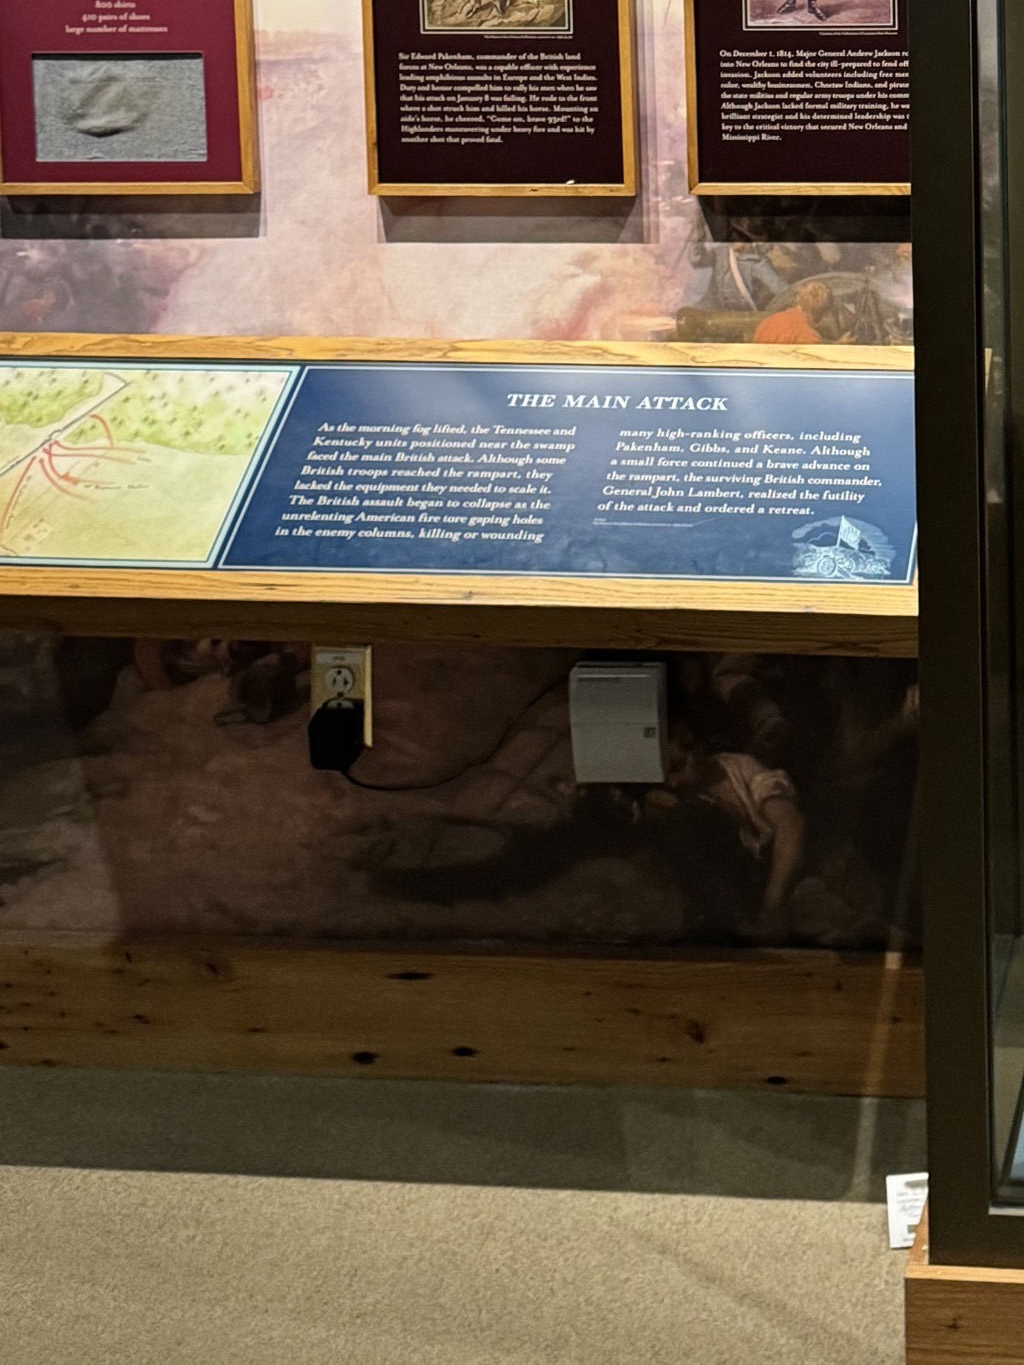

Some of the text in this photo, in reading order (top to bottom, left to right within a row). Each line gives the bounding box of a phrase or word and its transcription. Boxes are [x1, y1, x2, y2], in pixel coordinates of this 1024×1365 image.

[506, 393, 729, 411] THE MAIN ATTACK
[317, 422, 577, 436] As the morning fog lifted, the Tennessee and
[619, 427, 862, 445] many high-ranking officers, including
[312, 436, 576, 453] Kentucky units positioned near the swamp
[615, 441, 871, 459] Pakenham, Gibbs, and Keane. Although
[306, 450, 567, 467] faced the main British attack. Although some
[620, 456, 655, 467] small
[656, 457, 689, 467] force
[690, 458, 754, 469] continued
[755, 461, 764, 469] a
[766, 459, 800, 470] brave
[801, 459, 851, 471] advance
[853, 463, 871, 471] on
[300, 465, 554, 482] British troops reached the rampart, they
[606, 471, 883, 487] the rampart, the surviving British commander,
[293, 480, 552, 495] lacked the equipment they needed to scale it.
[602, 486, 866, 504] General John Lambert, realized the futility
[597, 501, 614, 511] of
[613, 501, 635, 512] the
[636, 502, 675, 512] attack
[676, 502, 702, 513] and
[704, 503, 756, 514] ordered
[768, 506, 815, 515] retreat.
